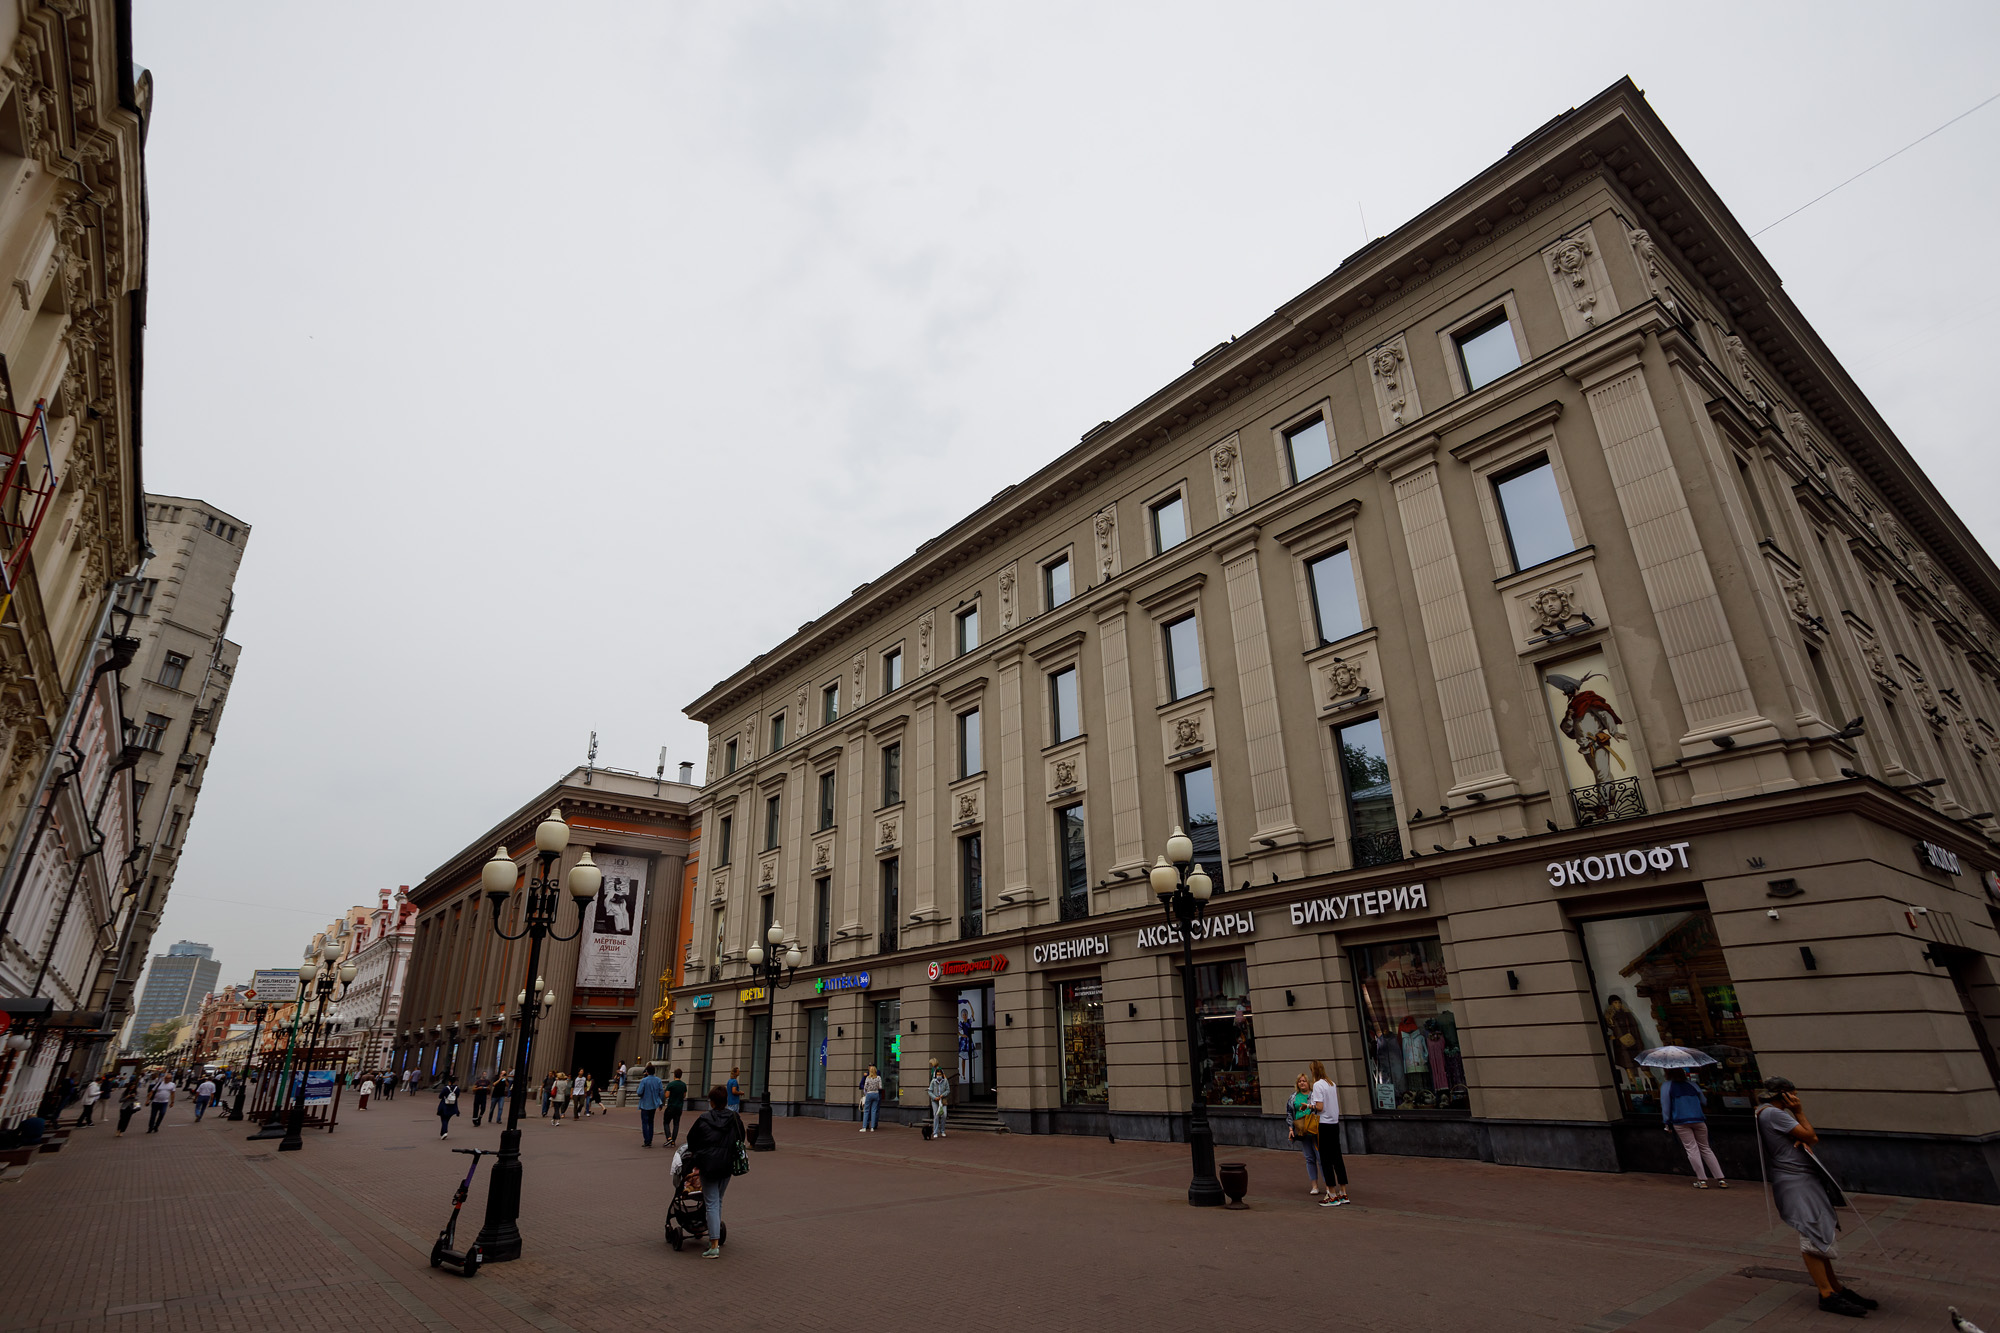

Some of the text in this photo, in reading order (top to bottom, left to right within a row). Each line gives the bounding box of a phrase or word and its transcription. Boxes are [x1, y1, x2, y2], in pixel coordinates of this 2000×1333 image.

[1546, 841, 1690, 887] ЭКОЛОФТ
[1289, 883, 1428, 926] БИЖУТЕРИЯ
[598, 944, 620, 952] ДУШИ
[1033, 934, 1109, 963] СУВЕНИРЫ
[824, 975, 861, 991] АПТЕКА
[740, 987, 764, 1004] ЦВЕТЫ
